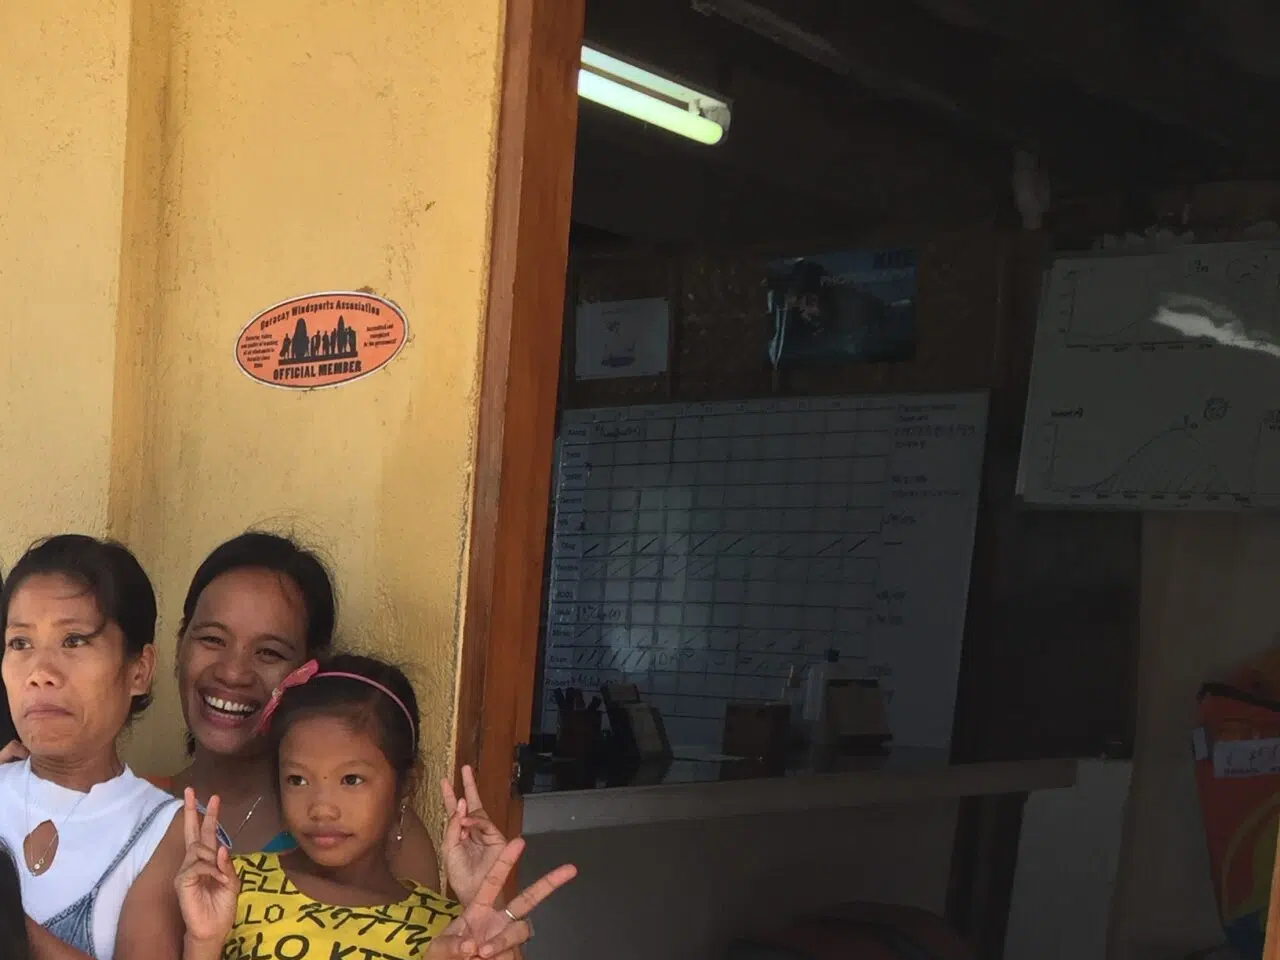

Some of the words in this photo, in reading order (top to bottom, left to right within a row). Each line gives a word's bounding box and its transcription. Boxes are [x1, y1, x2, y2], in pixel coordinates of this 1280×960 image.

[291, 301, 334, 317] Windsports
[335, 300, 381, 317] Association
[272, 368, 317, 381] OFFICIAL
[318, 360, 363, 376] MEMBER
